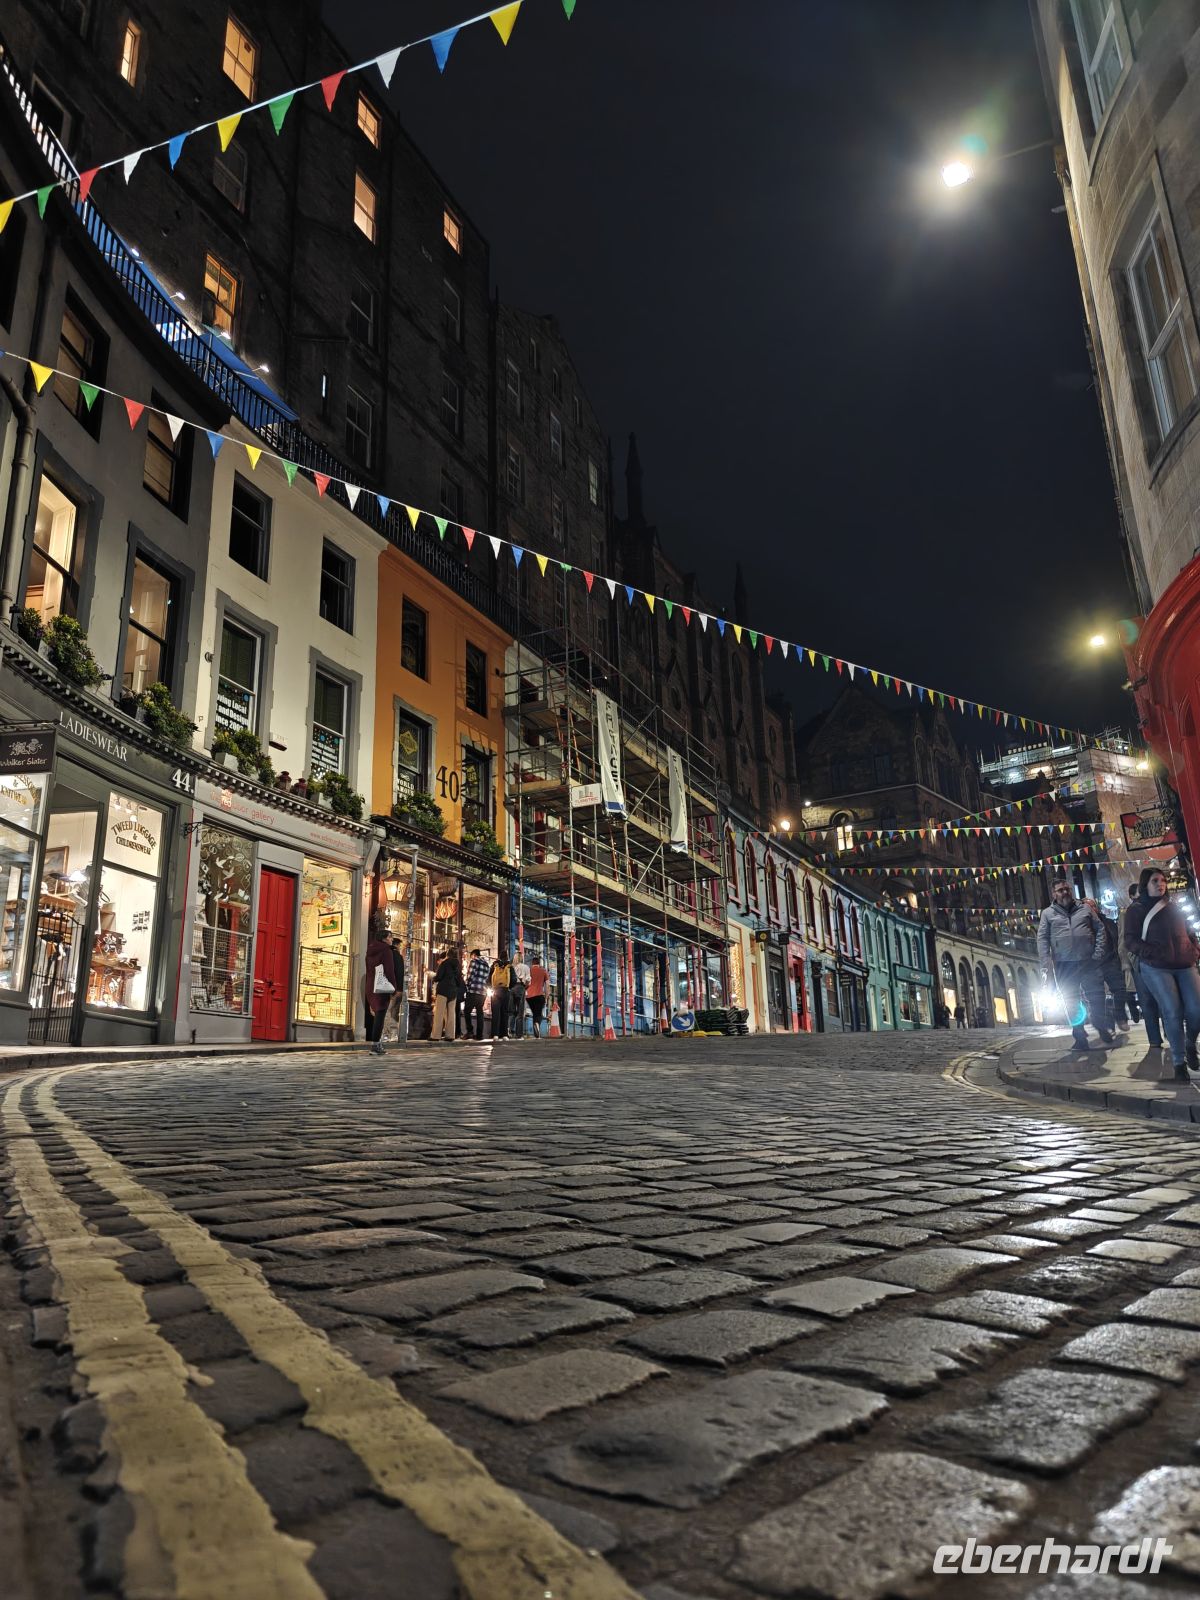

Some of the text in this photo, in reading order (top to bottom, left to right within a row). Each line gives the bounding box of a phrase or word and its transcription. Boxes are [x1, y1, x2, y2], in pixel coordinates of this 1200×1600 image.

[219, 705, 249, 726] and Design
[232, 700, 247, 714] Local
[60, 711, 128, 761] LADIESWEAR
[1, 757, 48, 767] Walker Slater
[436, 765, 460, 802] 40
[251, 809, 275, 824] gallery
[111, 821, 157, 850] TWEED LUGGAGE
[115, 836, 152, 856] CHILDRENSWEAR
